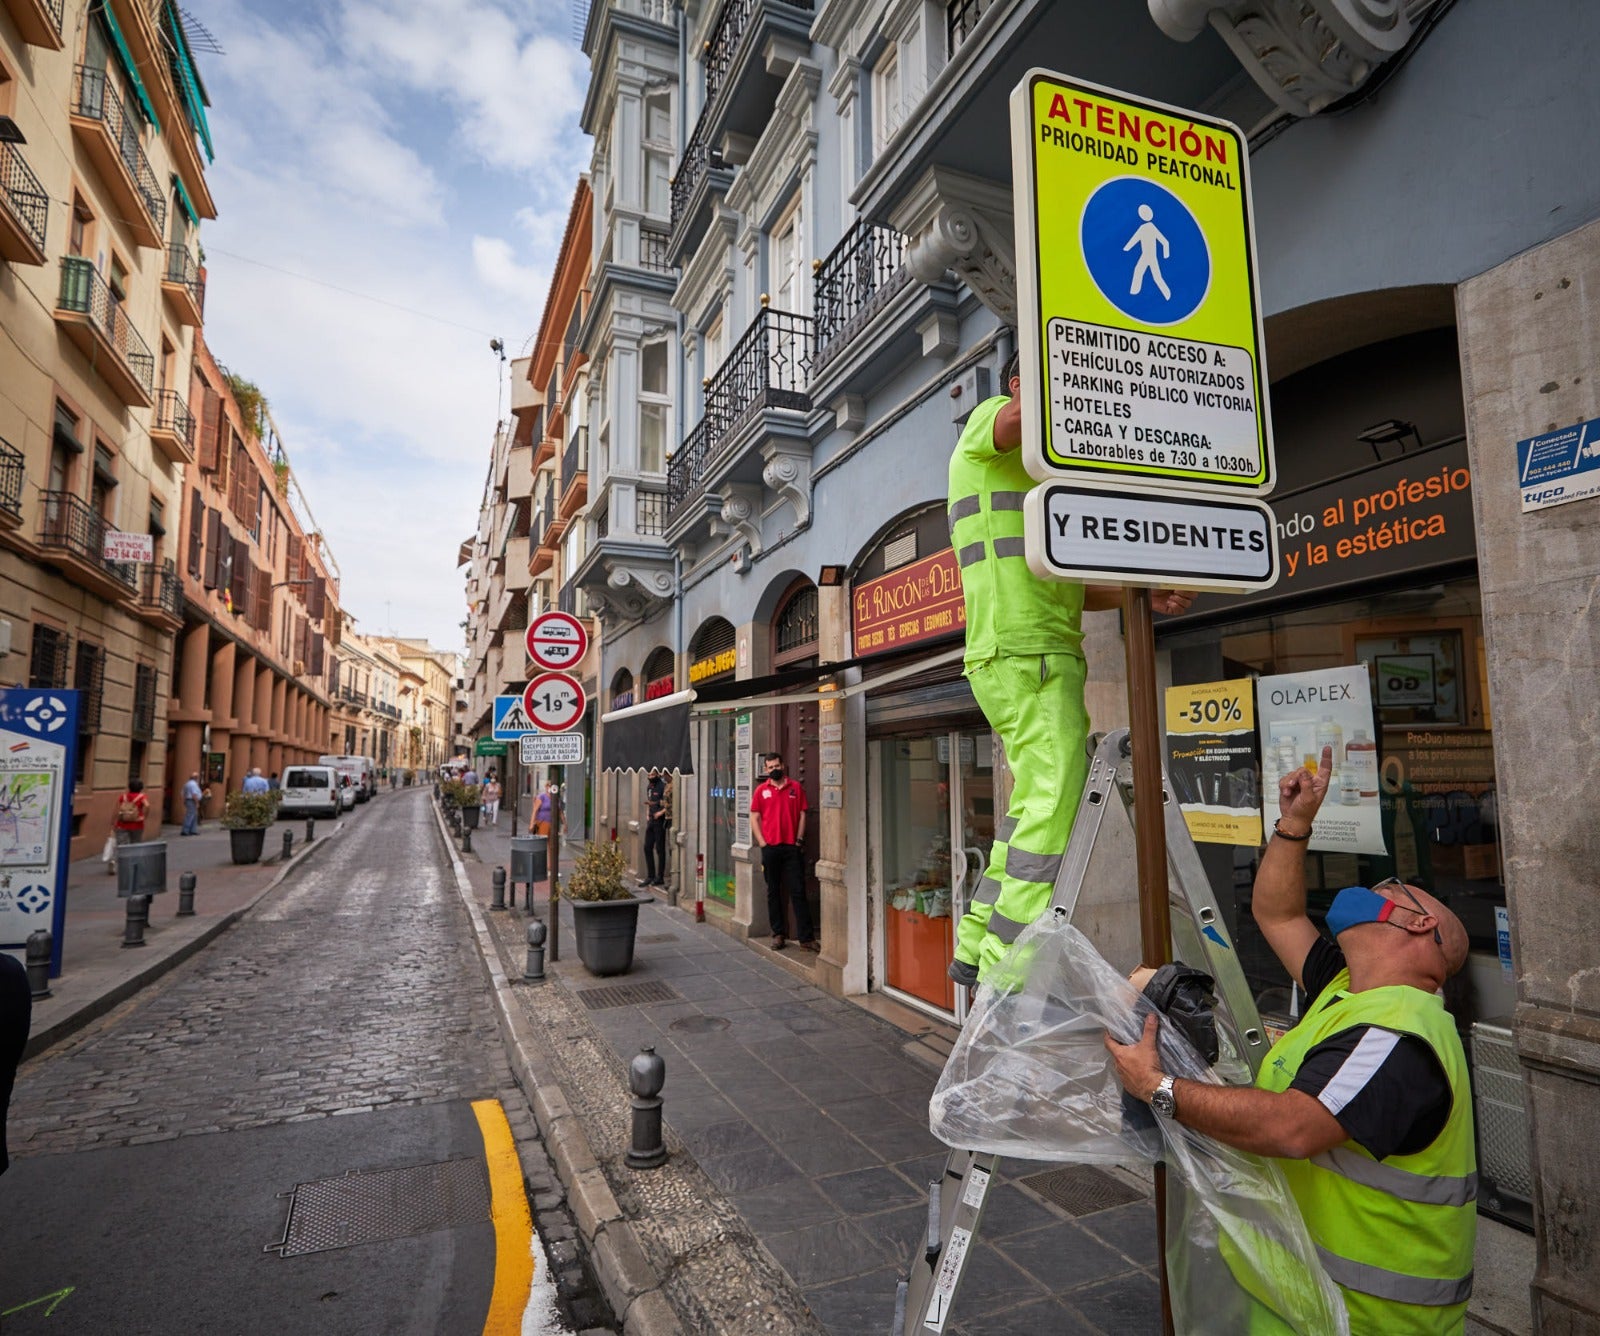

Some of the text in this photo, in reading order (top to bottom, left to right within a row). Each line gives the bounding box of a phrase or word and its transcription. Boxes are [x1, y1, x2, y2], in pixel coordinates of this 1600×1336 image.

[1048, 93, 1227, 165] ATENCIÓN
[1041, 124, 1236, 190] PRIORIDAD PEATONAL
[1055, 323, 1226, 368] PERMITIDO ACCESO A:
[1060, 349, 1143, 377] VEHÍCULOS
[1149, 364, 1245, 391] AUTORIZADOS
[1062, 372, 1124, 396] PARKING
[1130, 381, 1188, 404] PÚBLICO
[1193, 391, 1254, 413] VICTORIA
[1063, 395, 1131, 419] HOTELES
[1064, 418, 1113, 439] CARGA
[1119, 425, 1128, 440] Y
[1135, 426, 1212, 450] DESCARGA:
[1535, 431, 1577, 447] Conectada
[1070, 438, 1144, 461] Laborables
[1150, 448, 1165, 463] de
[1170, 450, 1196, 467] 7:30
[1202, 456, 1209, 468] a
[1322, 498, 1344, 528] al
[1353, 466, 1470, 525] profesio
[1524, 487, 1565, 503] tyco
[1576, 489, 1588, 497] Fire
[1053, 513, 1265, 553] Y RESIDENTES
[1285, 513, 1446, 577] y la estética
[1179, 696, 1242, 724] -30%
[1172, 747, 1206, 760] Promoción
[1407, 732, 1442, 744] Pro-Duo
